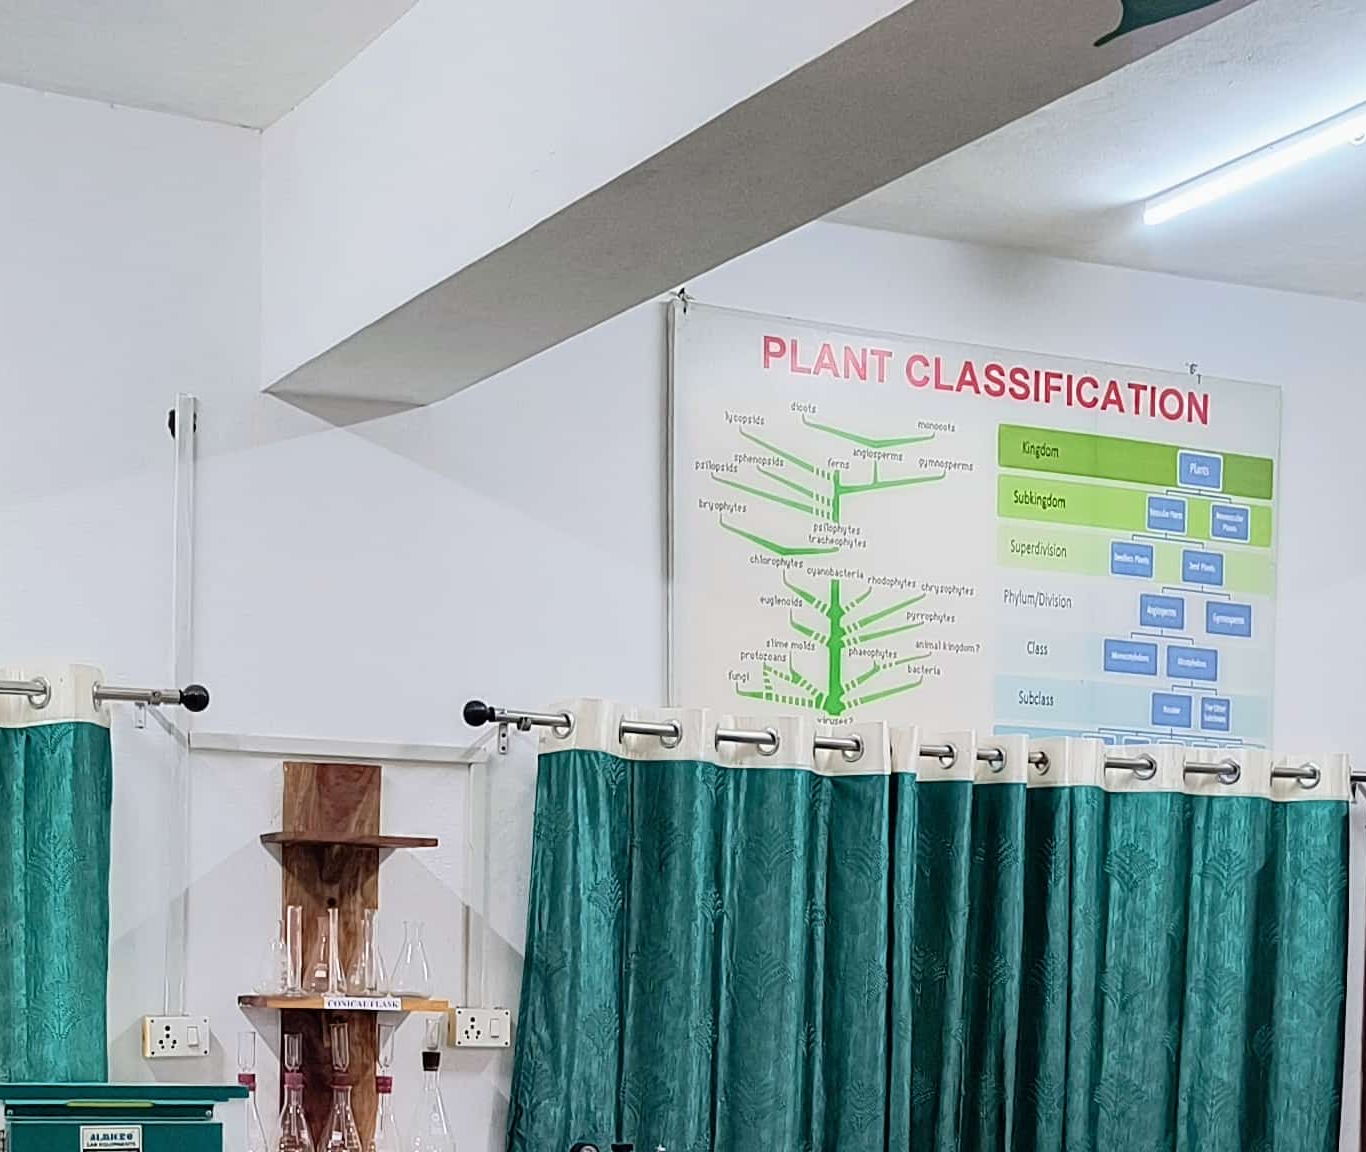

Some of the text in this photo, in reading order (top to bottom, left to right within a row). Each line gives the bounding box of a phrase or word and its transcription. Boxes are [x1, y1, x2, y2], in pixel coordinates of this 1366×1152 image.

[763, 335, 1209, 425] PLANT CLASSIFICATION
[790, 402, 816, 414] dicots
[724, 410, 765, 426] lycopsids
[917, 420, 955, 433] monocots
[853, 448, 903, 463] angiosperms
[1022, 440, 1059, 460] Kingdom
[695, 460, 738, 473] psilopsids
[734, 453, 784, 468] sphenopsids
[827, 456, 850, 471] ferns
[918, 457, 974, 472] gymnosperms
[1189, 462, 1210, 477] Plants
[698, 498, 747, 514] bryophytes
[1013, 490, 1066, 510] Subkingdom
[813, 522, 861, 536] psilophytes
[808, 533, 867, 548] tracheophytes
[1010, 538, 1067, 558] Superdivision
[749, 555, 804, 569] chlorophytes
[806, 565, 864, 580] cyanobacteria
[867, 575, 916, 589] rhodophytes
[921, 582, 974, 597] chrysophytes
[760, 595, 803, 608] euglenoids
[1003, 589, 1072, 609] Phylum/Division
[906, 611, 955, 624] pyrrophytes
[766, 638, 815, 651] slime molds
[916, 639, 941, 651] animal
[1027, 641, 1048, 656] Class
[740, 650, 786, 662] protozoans
[848, 648, 897, 661] phaeophytes
[728, 671, 750, 682] fungi
[907, 664, 941, 676] bacteria
[1019, 690, 1054, 706] Subclass
[327, 999, 399, 1009] CONICAL FLASK
